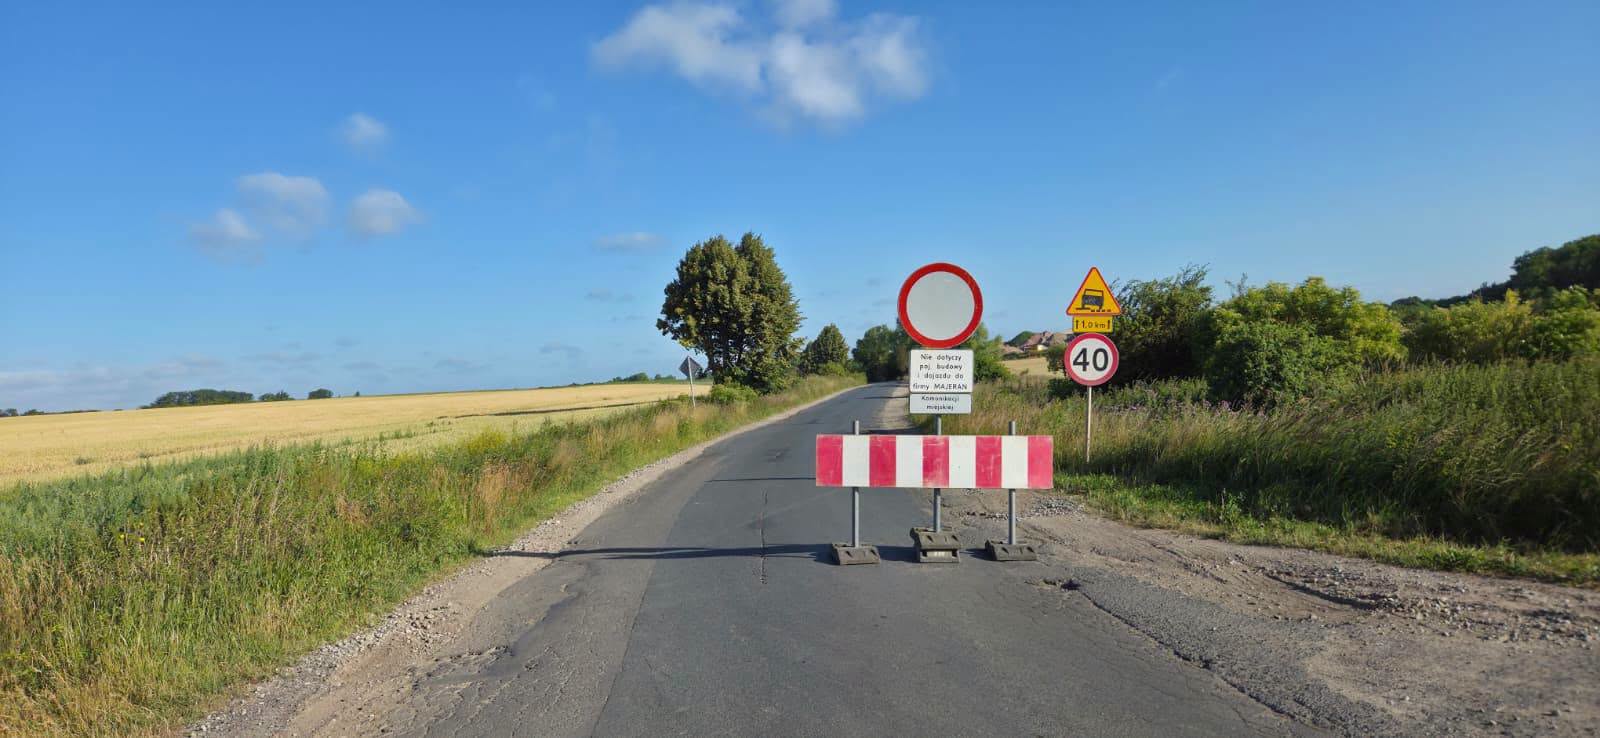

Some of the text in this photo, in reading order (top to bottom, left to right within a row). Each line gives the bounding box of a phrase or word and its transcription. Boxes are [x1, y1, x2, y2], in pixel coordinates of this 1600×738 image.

[1095, 320, 1106, 328] km
[1072, 347, 1109, 372] 40
[936, 363, 963, 371] budowy
